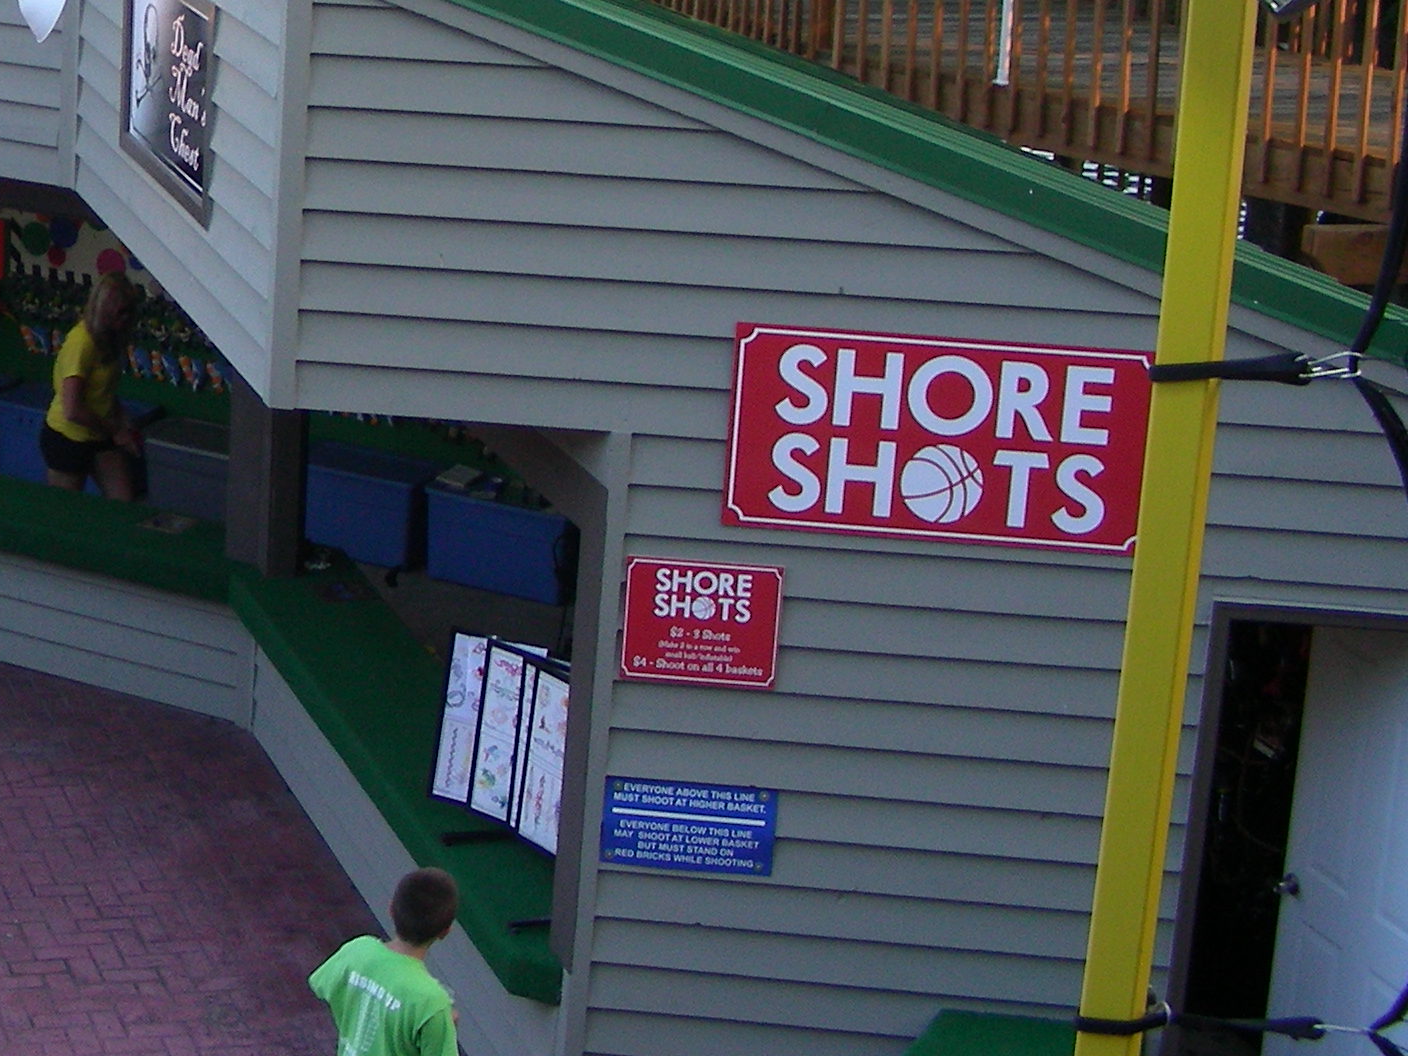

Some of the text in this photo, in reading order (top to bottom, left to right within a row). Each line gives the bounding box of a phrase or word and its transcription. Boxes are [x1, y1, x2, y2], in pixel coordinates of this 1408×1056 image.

[171, 14, 204, 71] Dead
[169, 62, 207, 127] Man's
[169, 112, 200, 171] Chest
[775, 344, 1116, 446] SHORE
[767, 432, 1106, 536] SHOTS
[655, 568, 753, 598] SHORE
[653, 594, 751, 624] SHOTS
[702, 629, 731, 642] Shots
[632, 655, 646, 668] $4
[655, 658, 684, 670] Shoot
[687, 663, 700, 672] on
[702, 662, 714, 673] all
[716, 663, 723, 673] 4
[725, 663, 763, 676] baskets
[613, 792, 640, 802] MUST
[642, 794, 674, 806] SHOOT
[675, 798, 687, 807] AT
[689, 800, 725, 811] HIGHER
[624, 782, 755, 802] EVERYONE ABOVE THIS LINE
[613, 828, 760, 849] MAY SHOOT AT LOWER BASKET
[619, 819, 752, 839] EVERYONE BELOW THIS LINE
[614, 847, 754, 868] RED BRICKS WHILE SHOOTING
[637, 840, 734, 856] BUT MUST STAND ON
